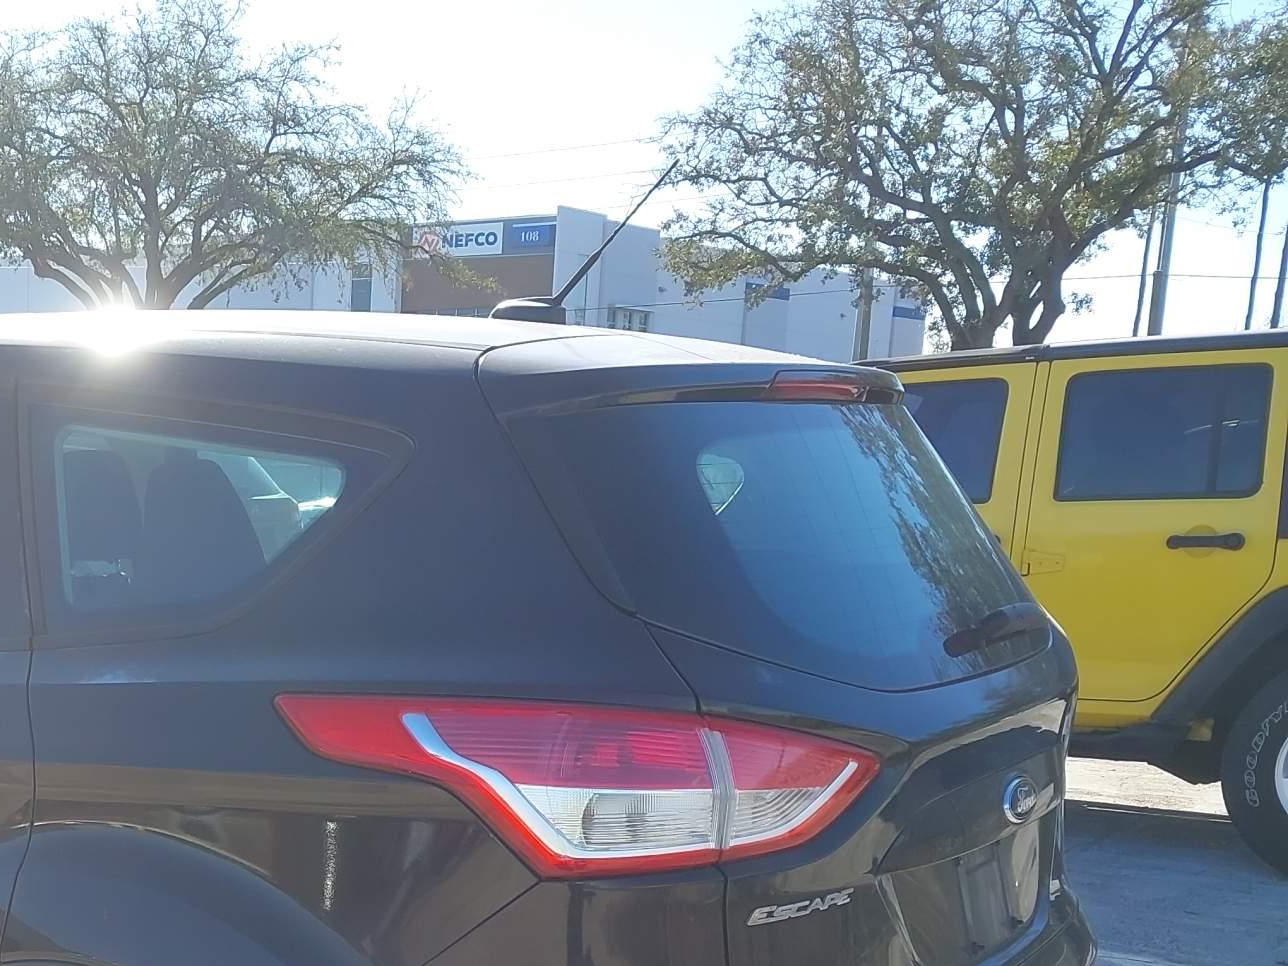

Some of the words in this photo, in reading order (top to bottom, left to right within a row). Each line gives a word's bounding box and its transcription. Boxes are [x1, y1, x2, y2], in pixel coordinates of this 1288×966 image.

[442, 231, 498, 248] NEFCO
[521, 231, 539, 242] 108
[747, 887, 854, 926] ESCAPE
